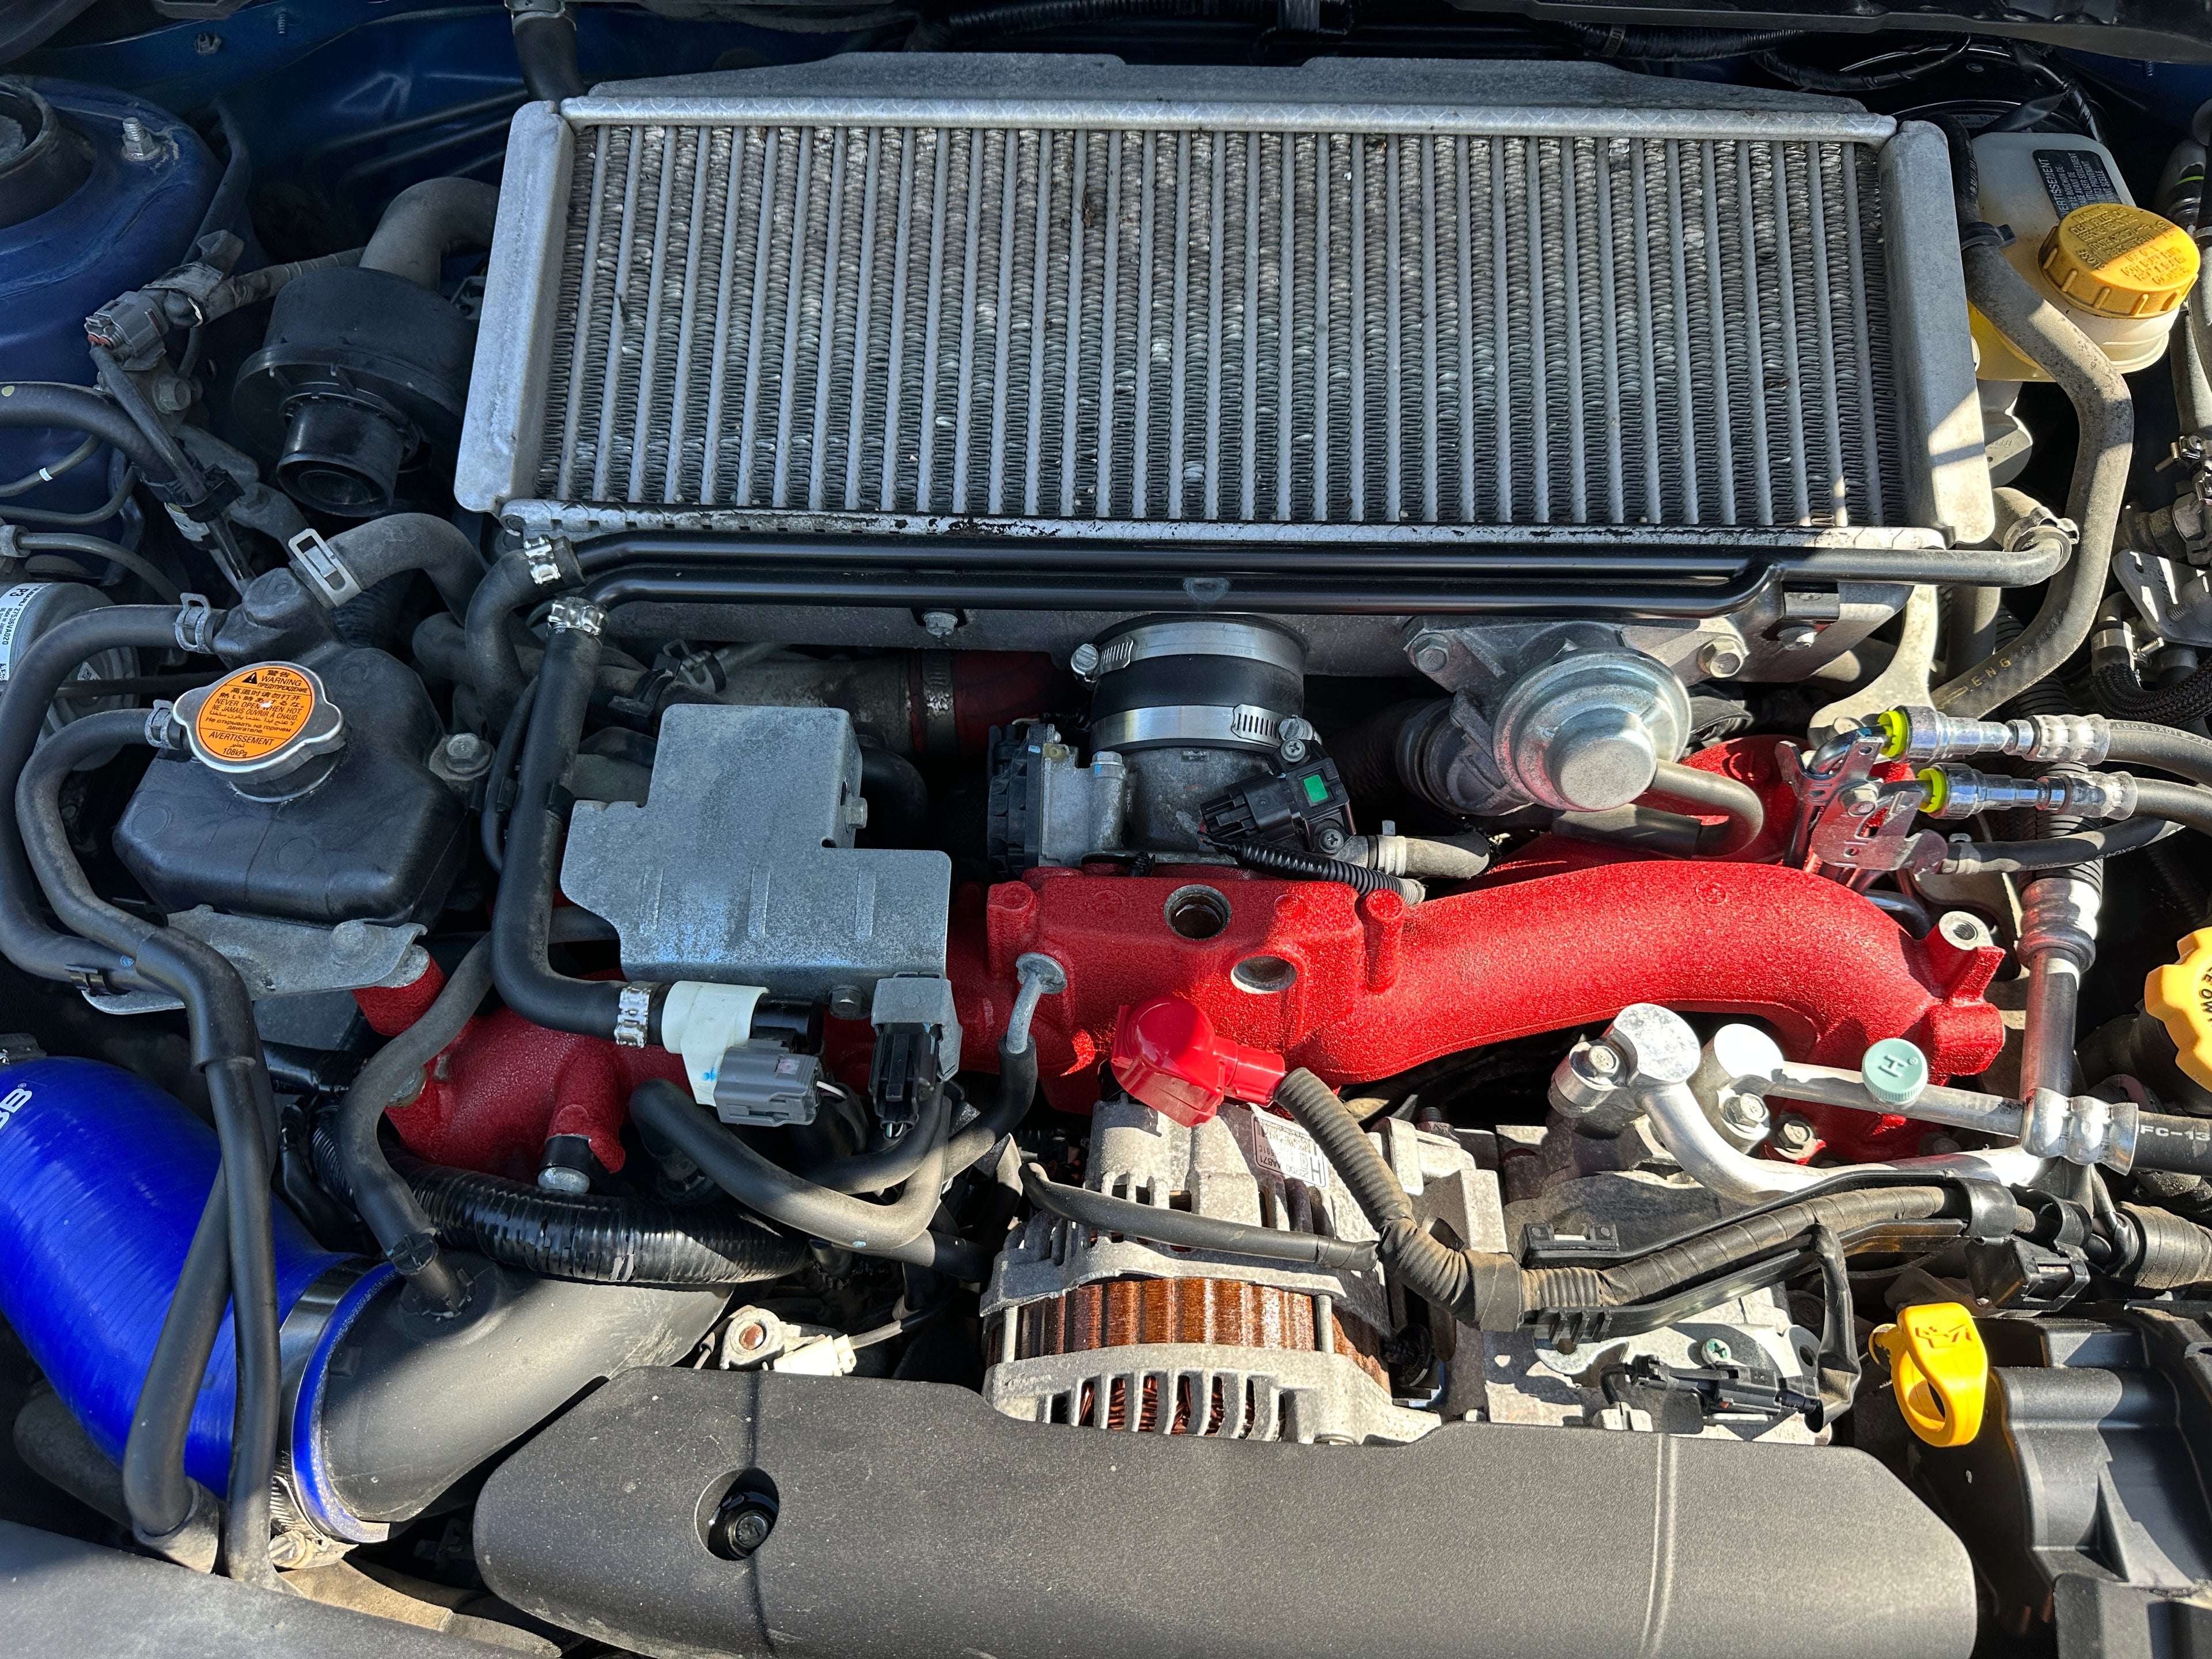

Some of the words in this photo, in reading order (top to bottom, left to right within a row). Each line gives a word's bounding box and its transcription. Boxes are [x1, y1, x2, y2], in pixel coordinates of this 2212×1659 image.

[9, 588, 29, 597] P3
[1971, 657, 2012, 687] ENG
[261, 676, 302, 687] WARNING
[257, 683, 309, 693] ПРЕДУПРЕЖДЕНИЕ
[215, 698, 238, 706] NEVER
[222, 706, 244, 714] JAMAIS
[217, 719, 252, 728] открывать
[209, 731, 275, 746] AVERTISSEMENT
[223, 748, 248, 757] 108kPa
[1878, 1054, 1909, 1078] H
[2139, 1124, 2211, 1141] FC-13
